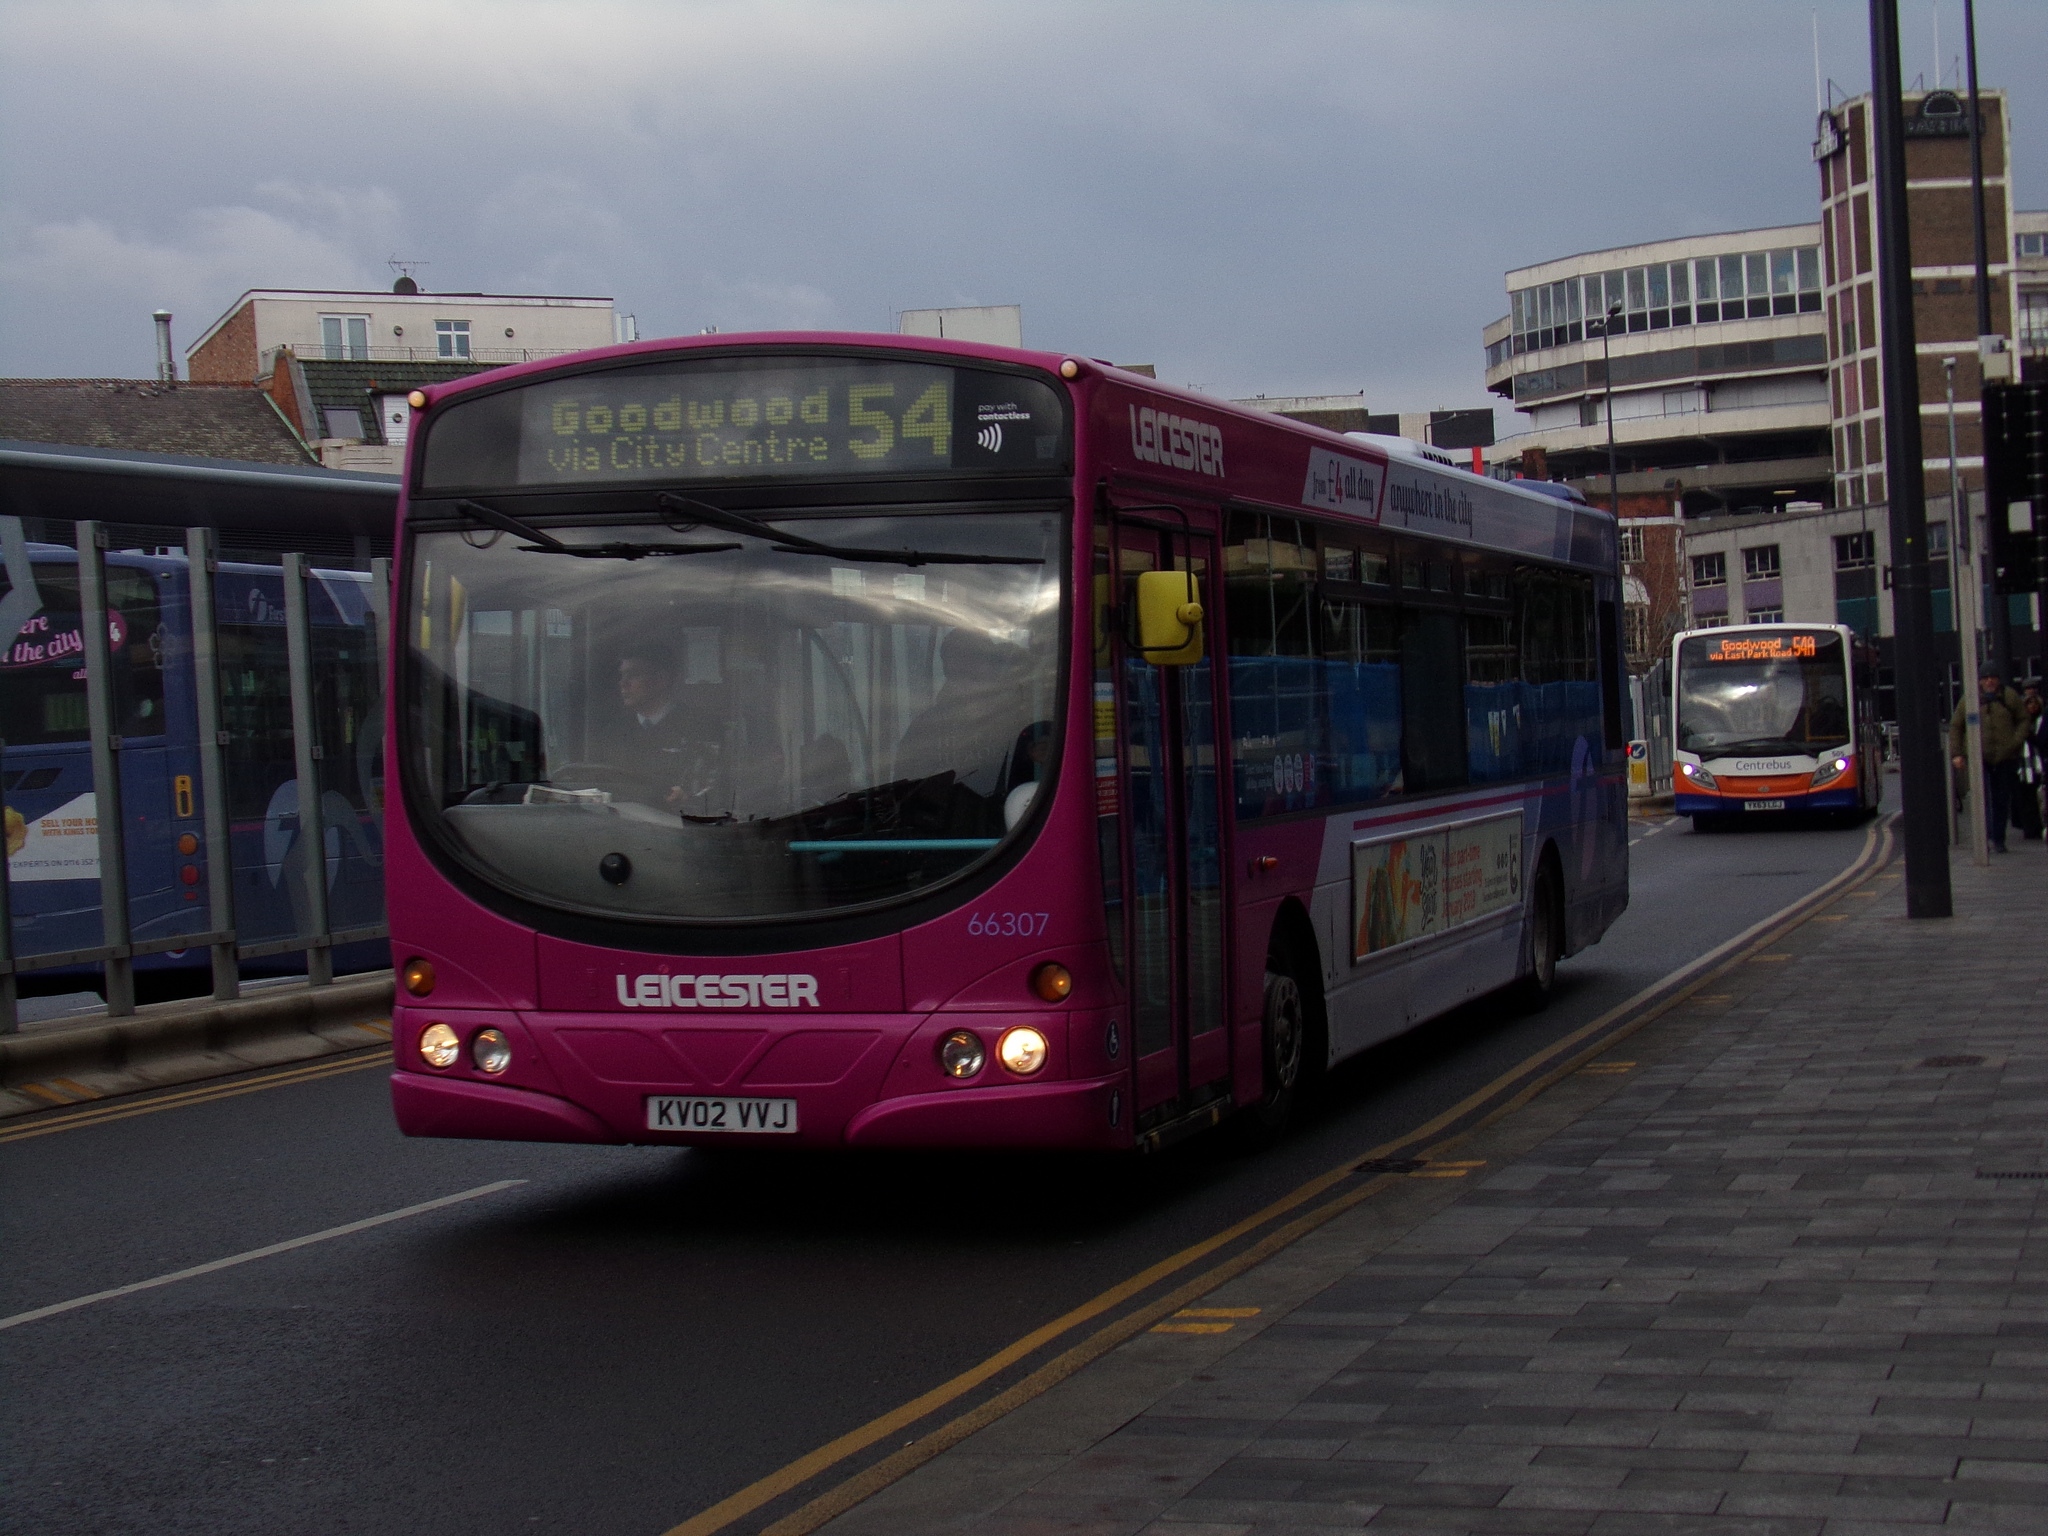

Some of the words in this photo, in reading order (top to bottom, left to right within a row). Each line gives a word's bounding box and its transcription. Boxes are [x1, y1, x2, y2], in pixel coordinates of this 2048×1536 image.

[552, 386, 828, 435] Goodwood
[848, 379, 952, 459] 54
[977, 412, 1031, 421] contactless
[978, 404, 995, 413] pay
[996, 402, 1018, 411] with
[548, 438, 600, 471] via
[611, 435, 685, 468] City
[696, 429, 829, 466] Centre
[1129, 403, 1226, 478] LEICESTER
[1313, 471, 1327, 500] from
[1344, 466, 1357, 500] all
[1358, 468, 1375, 514] day
[1390, 479, 1434, 527] anywhere
[1433, 482, 1444, 520] in
[1444, 486, 1457, 524] the
[1458, 489, 1474, 539] city
[13, 641, 45, 662] the
[47, 628, 83, 657] city
[1709, 652, 1724, 661] via
[1725, 650, 1746, 660] East
[1747, 649, 1769, 659] Park
[1769, 647, 1793, 658] Road
[1721, 637, 1782, 651] Goodwood
[1735, 760, 1792, 771] Centrebus
[967, 912, 1050, 937] 66307
[616, 974, 821, 1008] LEICESTER
[658, 1100, 726, 1127] KV02
[738, 1102, 789, 1128] VVJ
